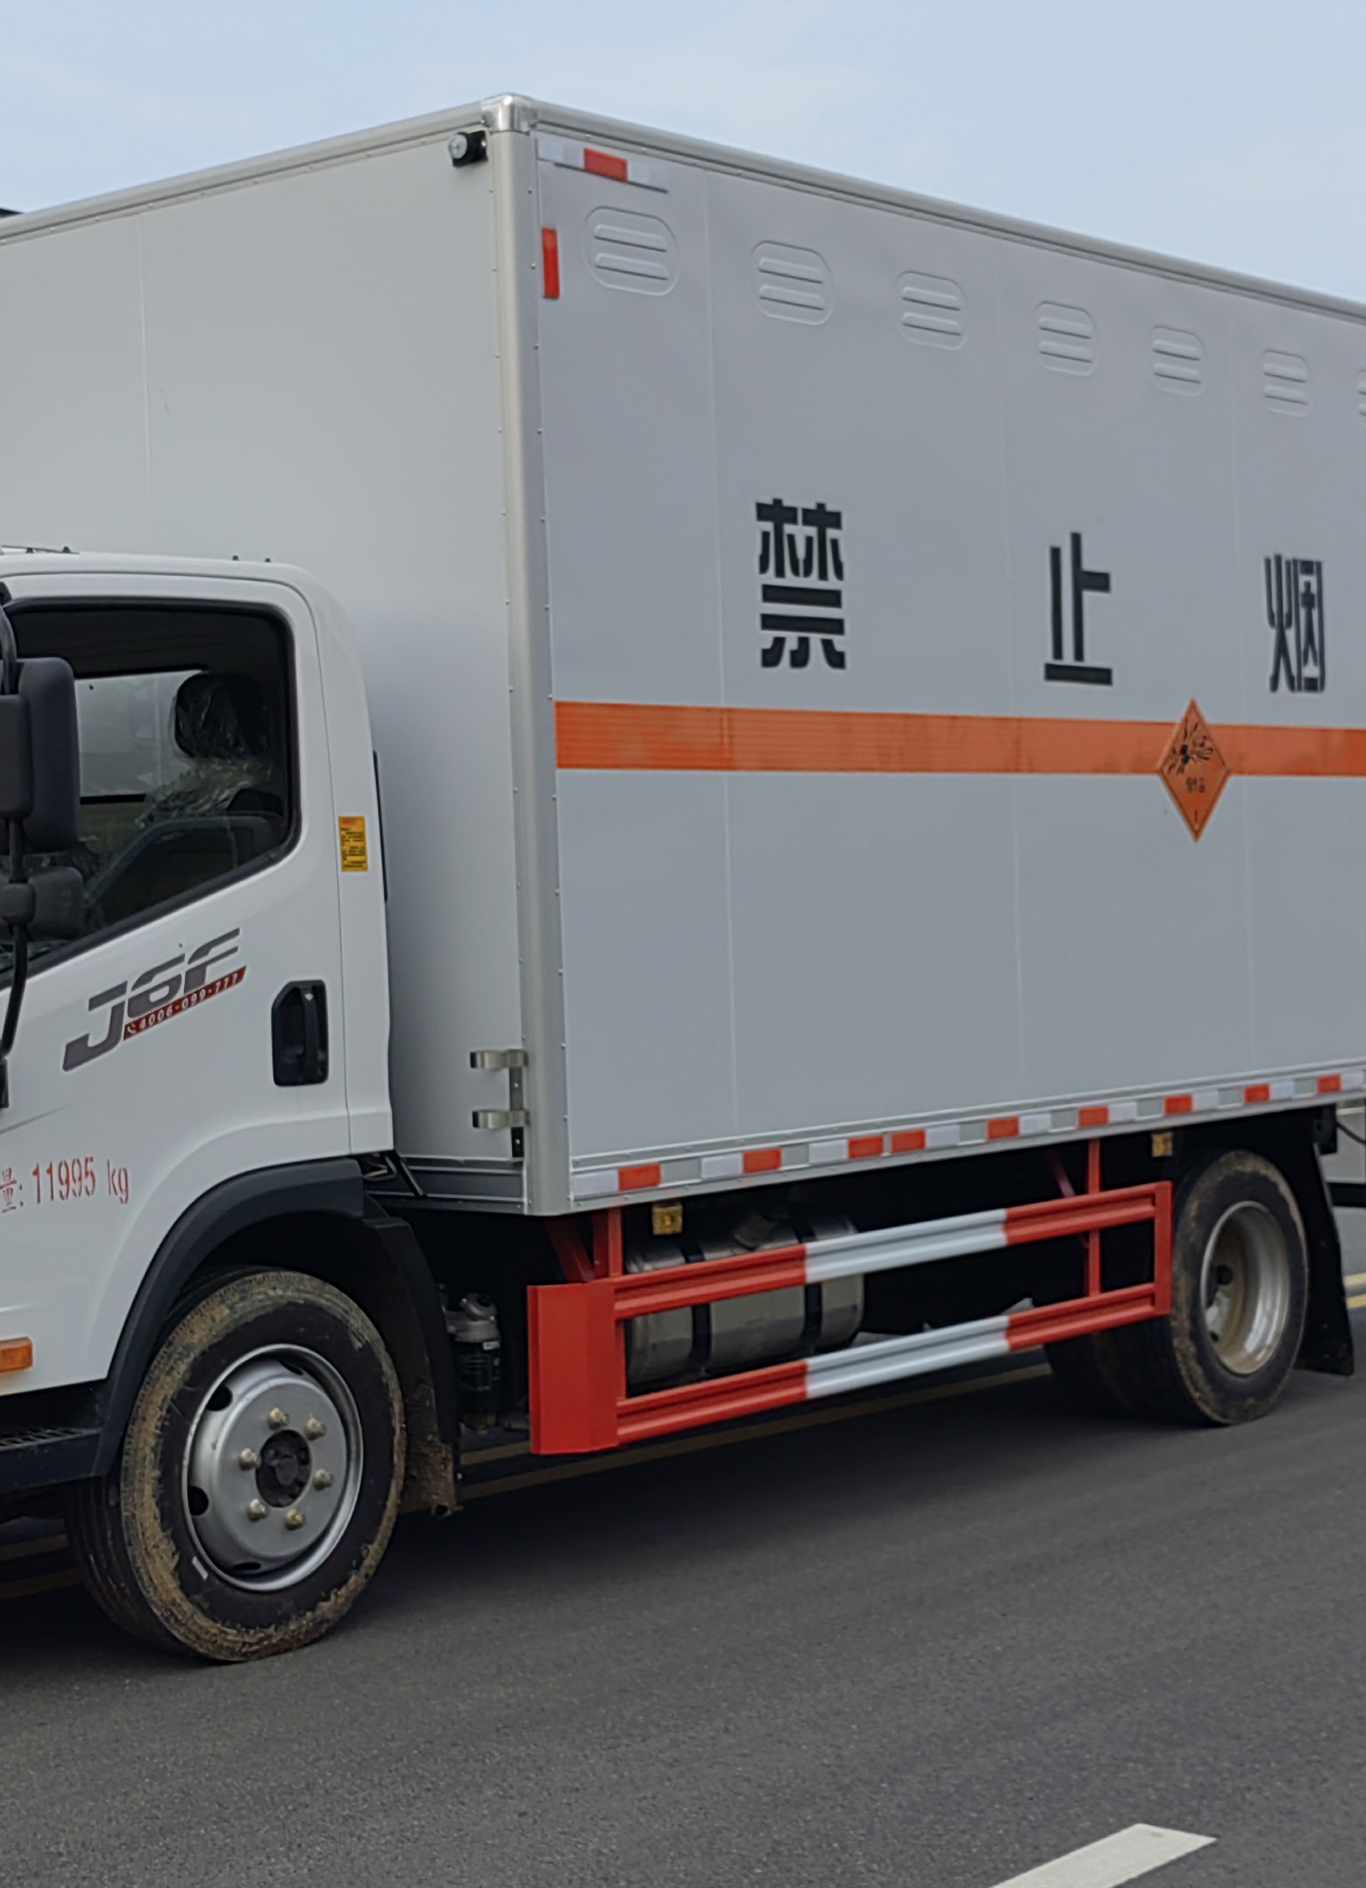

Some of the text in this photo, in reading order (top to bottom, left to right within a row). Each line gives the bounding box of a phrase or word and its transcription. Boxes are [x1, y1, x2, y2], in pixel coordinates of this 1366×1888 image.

[62, 927, 241, 1072] J6F
[32, 1156, 97, 1204] 11995
[107, 1159, 129, 1204] kg
